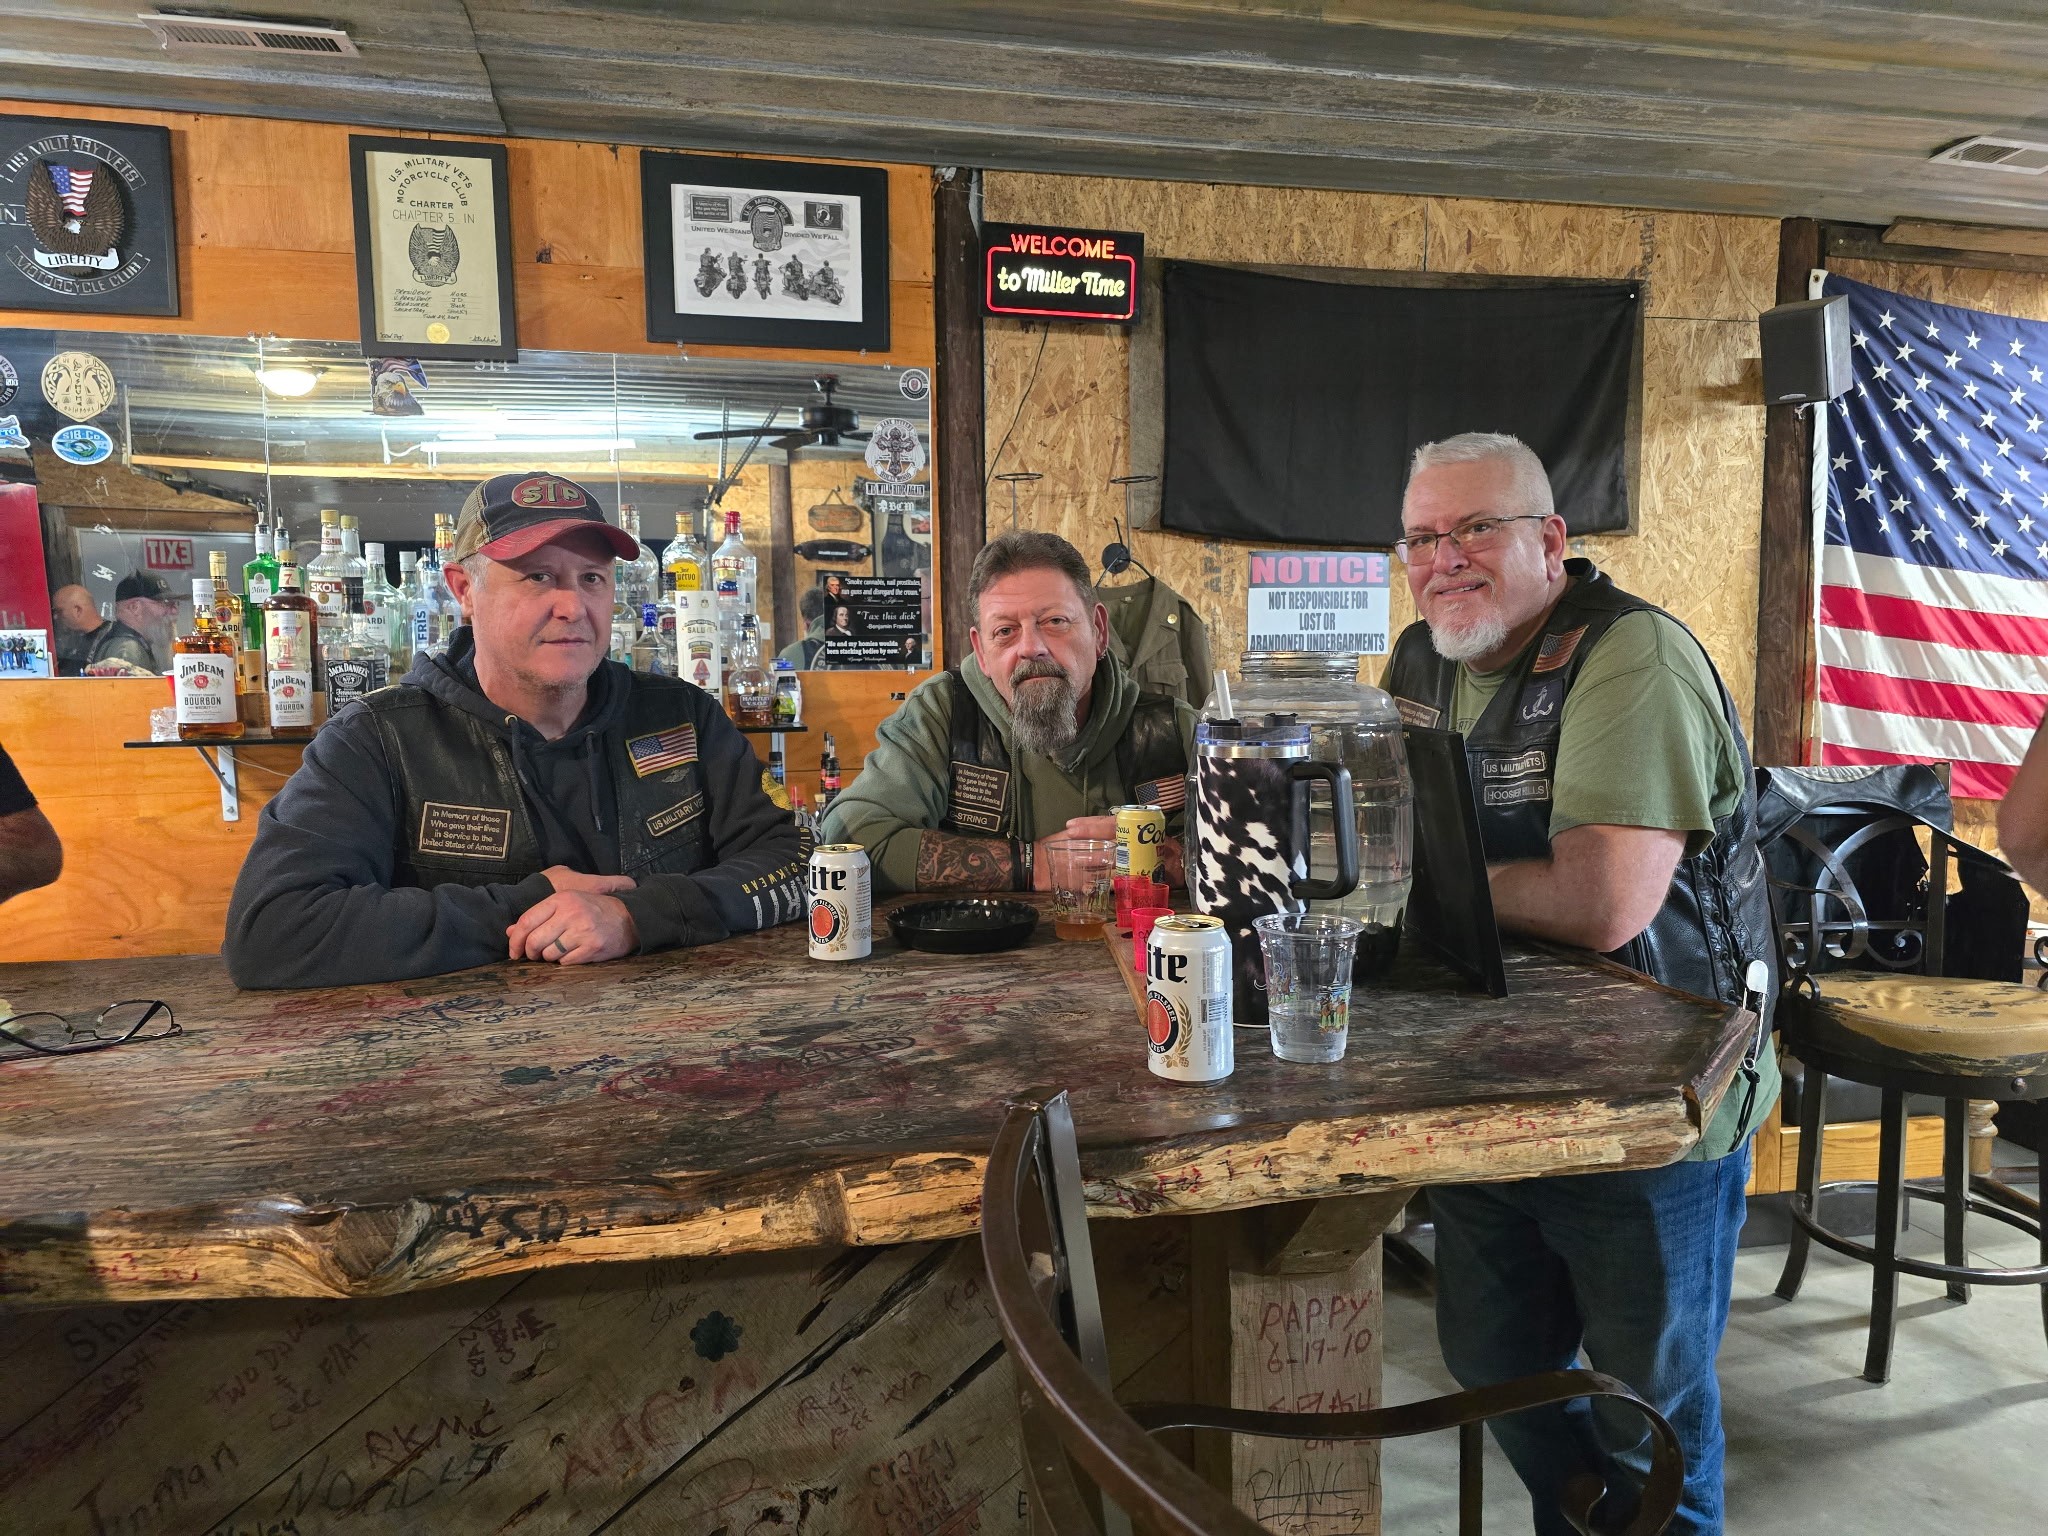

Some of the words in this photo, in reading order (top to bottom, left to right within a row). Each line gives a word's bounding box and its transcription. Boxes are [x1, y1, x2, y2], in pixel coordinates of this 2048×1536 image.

[28, 136, 99, 159] MILITARY
[105, 150, 140, 183] VETS
[404, 157, 452, 170] MILITARY
[453, 166, 473, 189] VETS
[396, 170, 450, 204] MOTORCYCLE
[450, 181, 468, 207] CLUB
[409, 199, 454, 209] CHARTER
[392, 209, 444, 223] CHAPTER
[448, 212, 455, 223] 5
[463, 213, 475, 224] IN
[690, 225, 716, 233] UNITED
[716, 226, 728, 234] WE
[1010, 233, 1115, 260] WELCOME
[47, 255, 104, 267] LIBERTY
[14, 255, 107, 294] MOTORCYCLE
[109, 260, 142, 288] CLUB
[997, 265, 1022, 292] to
[1021, 266, 1082, 295] Miller
[1081, 271, 1126, 297] Time
[1252, 556, 1385, 584] NOTICE
[283, 573, 293, 586] 7
[1268, 590, 1287, 611] NOT
[1288, 590, 1350, 610] RESPONSIBLE
[1351, 590, 1369, 610] FOR
[882, 611, 897, 620] this
[1299, 612, 1322, 631] LOST
[1323, 612, 1336, 631] OR
[1250, 634, 1305, 651] ABANDONED
[1306, 632, 1386, 652] UNDERGARMENTS
[179, 664, 197, 679] JIM
[197, 661, 225, 680] BEAM
[328, 664, 344, 678] JACK
[271, 678, 285, 690] JIM
[285, 675, 306, 689] BEAM
[184, 696, 222, 706] BOURBON
[274, 703, 305, 711] BOURBON
[963, 768, 980, 779] Memory
[985, 774, 998, 782] those
[1486, 764, 1498, 773] US
[432, 809, 440, 817] In
[440, 809, 470, 822] Memory
[480, 814, 501, 824] those
[652, 819, 664, 831] US
[662, 802, 694, 826] MILITARY
[430, 819, 448, 828] Who
[448, 823, 466, 831] gave
[466, 822, 484, 832] their
[483, 823, 500, 834] lives
[434, 828, 442, 838] in
[442, 830, 471, 841] Service
[472, 833, 480, 841] to
[481, 834, 493, 843] the
[422, 837, 444, 847] United
[444, 840, 466, 849] States
[466, 842, 475, 850] of
[474, 843, 503, 853] America
[1147, 943, 1188, 986] ite
[1153, 991, 1178, 1022] PILSNER
[1257, 1290, 1373, 1341] PAPPY
